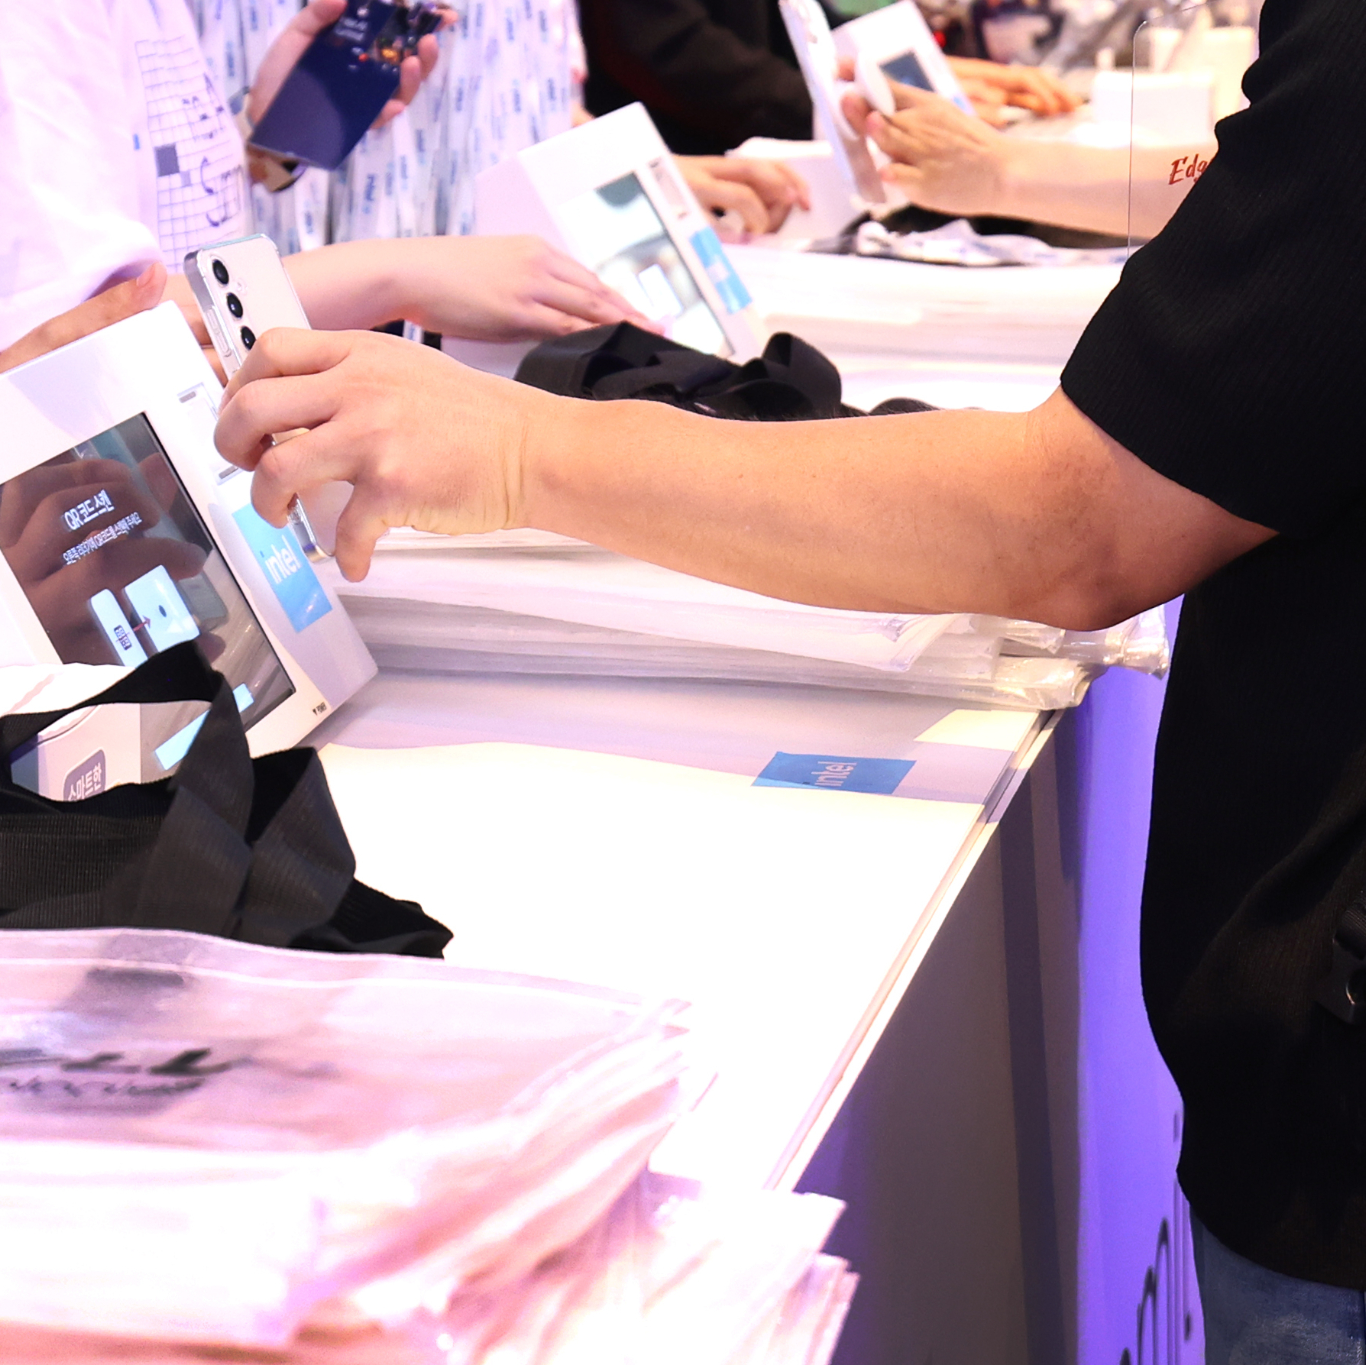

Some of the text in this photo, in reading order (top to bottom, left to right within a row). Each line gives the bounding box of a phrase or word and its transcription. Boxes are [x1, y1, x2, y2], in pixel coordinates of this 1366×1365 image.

[64, 499, 99, 530] QR코드
[260, 534, 302, 585] intel
[802, 761, 858, 787] intel
